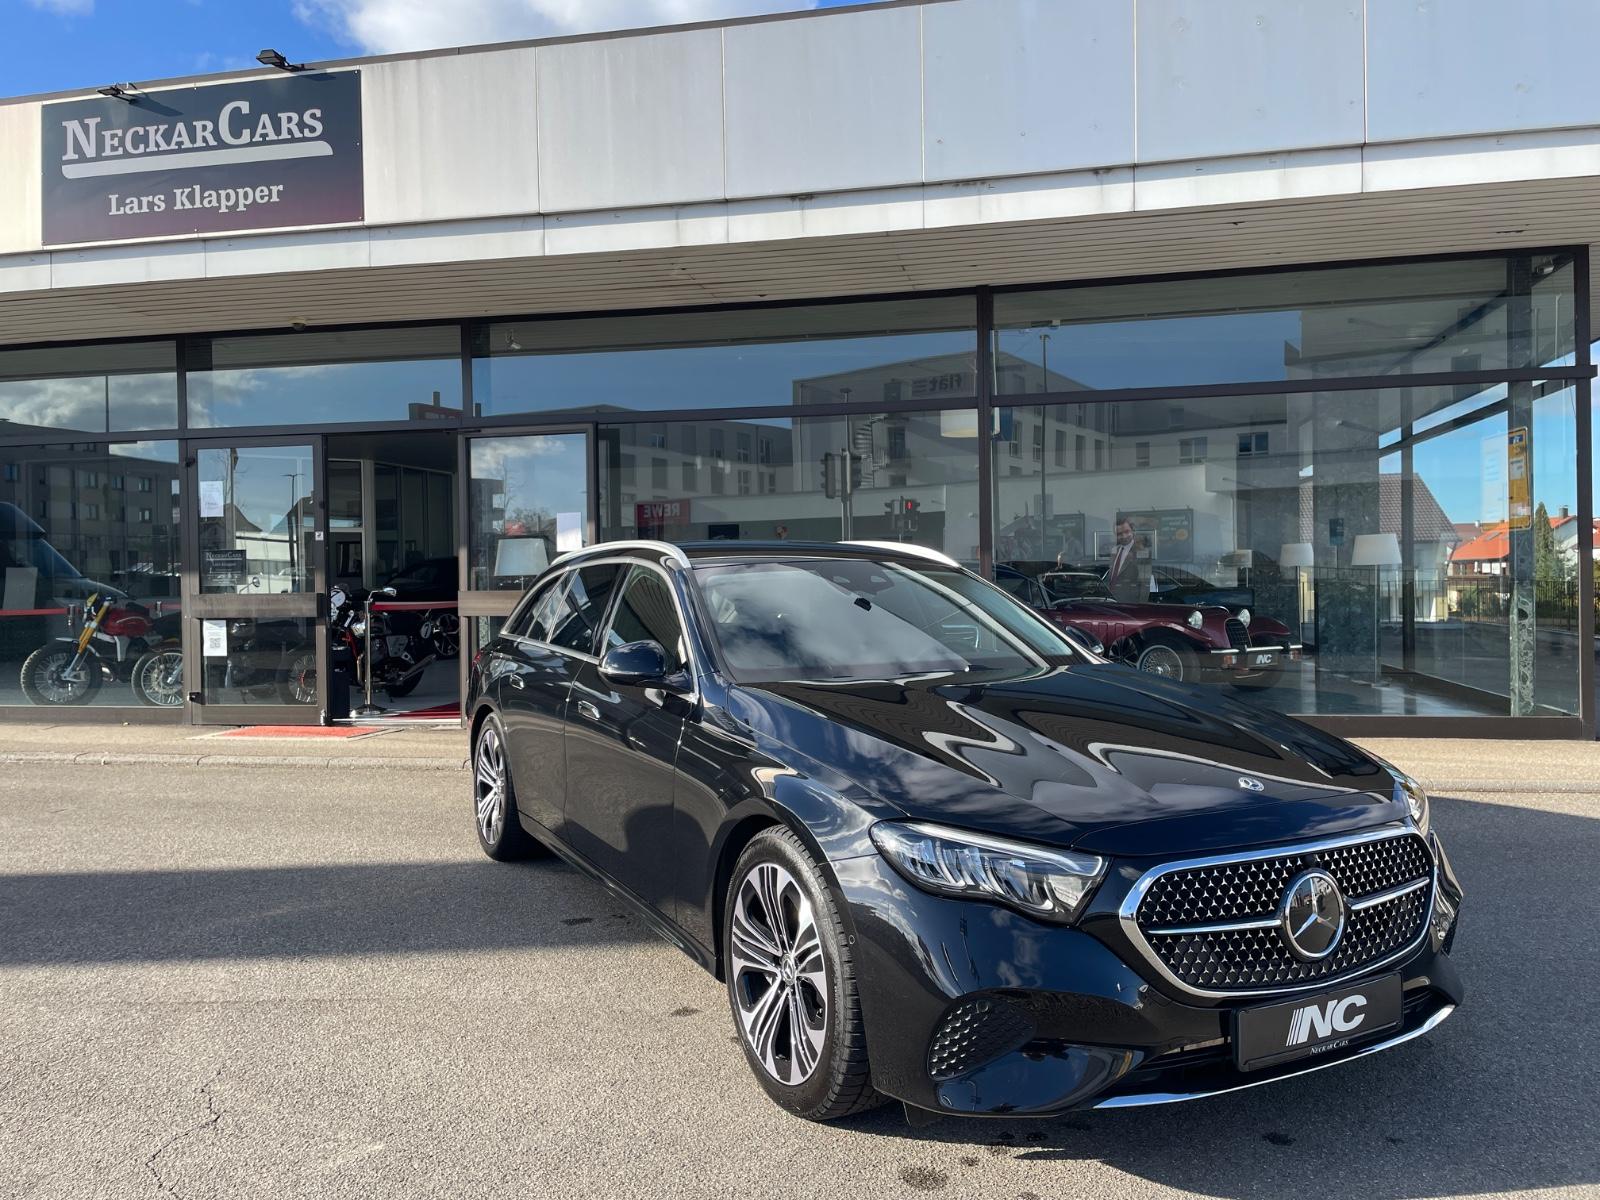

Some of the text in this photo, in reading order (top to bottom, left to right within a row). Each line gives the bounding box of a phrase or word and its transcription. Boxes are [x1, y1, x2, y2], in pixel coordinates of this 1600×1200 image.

[108, 184, 284, 216] Lars Klapper
[1286, 995, 1367, 1046] NC
